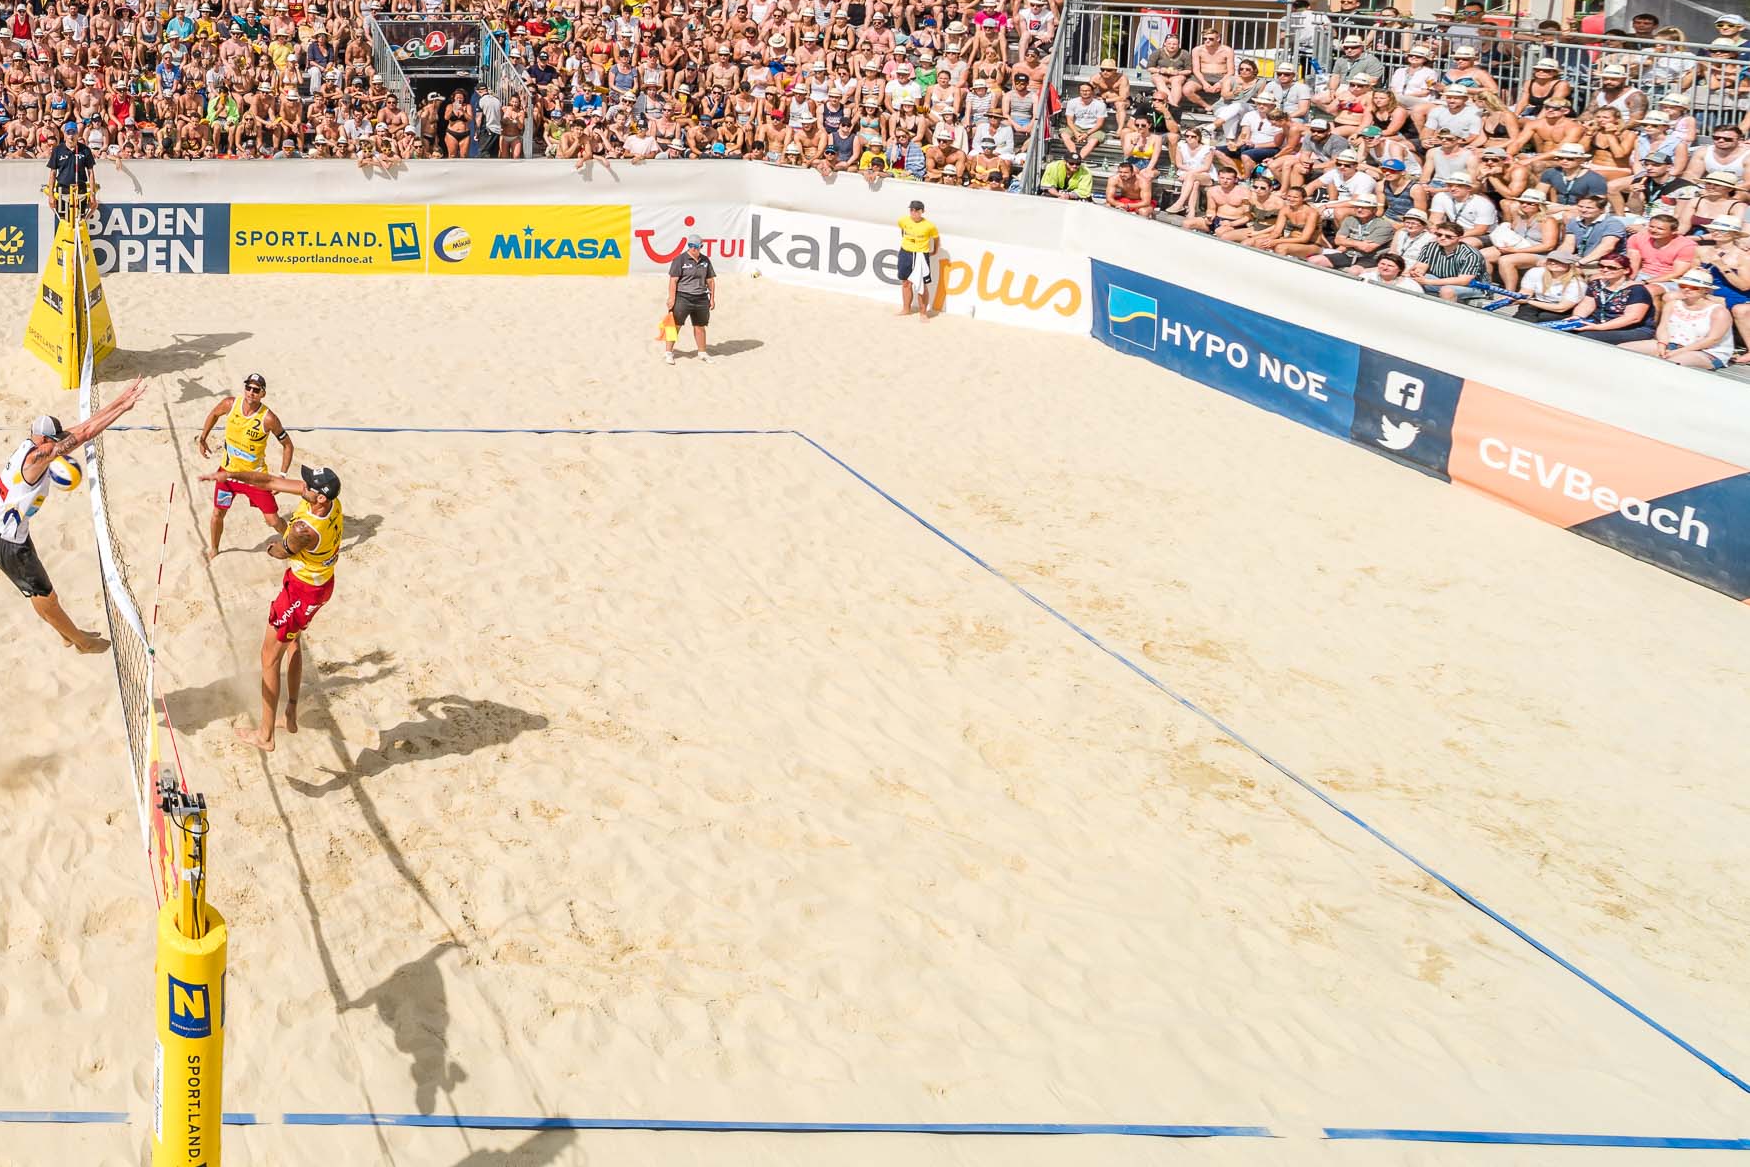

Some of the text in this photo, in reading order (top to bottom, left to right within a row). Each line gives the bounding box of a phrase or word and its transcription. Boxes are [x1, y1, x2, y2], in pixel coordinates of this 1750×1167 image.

[86, 208, 203, 236] BADEN
[236, 231, 382, 247] SPORT.LAND.
[703, 239, 745, 257] TUI
[90, 240, 203, 273] OPEN
[256, 254, 373, 264] www.sportlandnoe.at
[1161, 318, 1329, 402] HYPO NOE
[246, 429, 259, 438] AUT
[252, 419, 261, 431] 2
[1479, 438, 1709, 548] CEVBeach
[273, 600, 301, 626] VAPIANO
[187, 1056, 200, 1163] SPORT.LAND.
